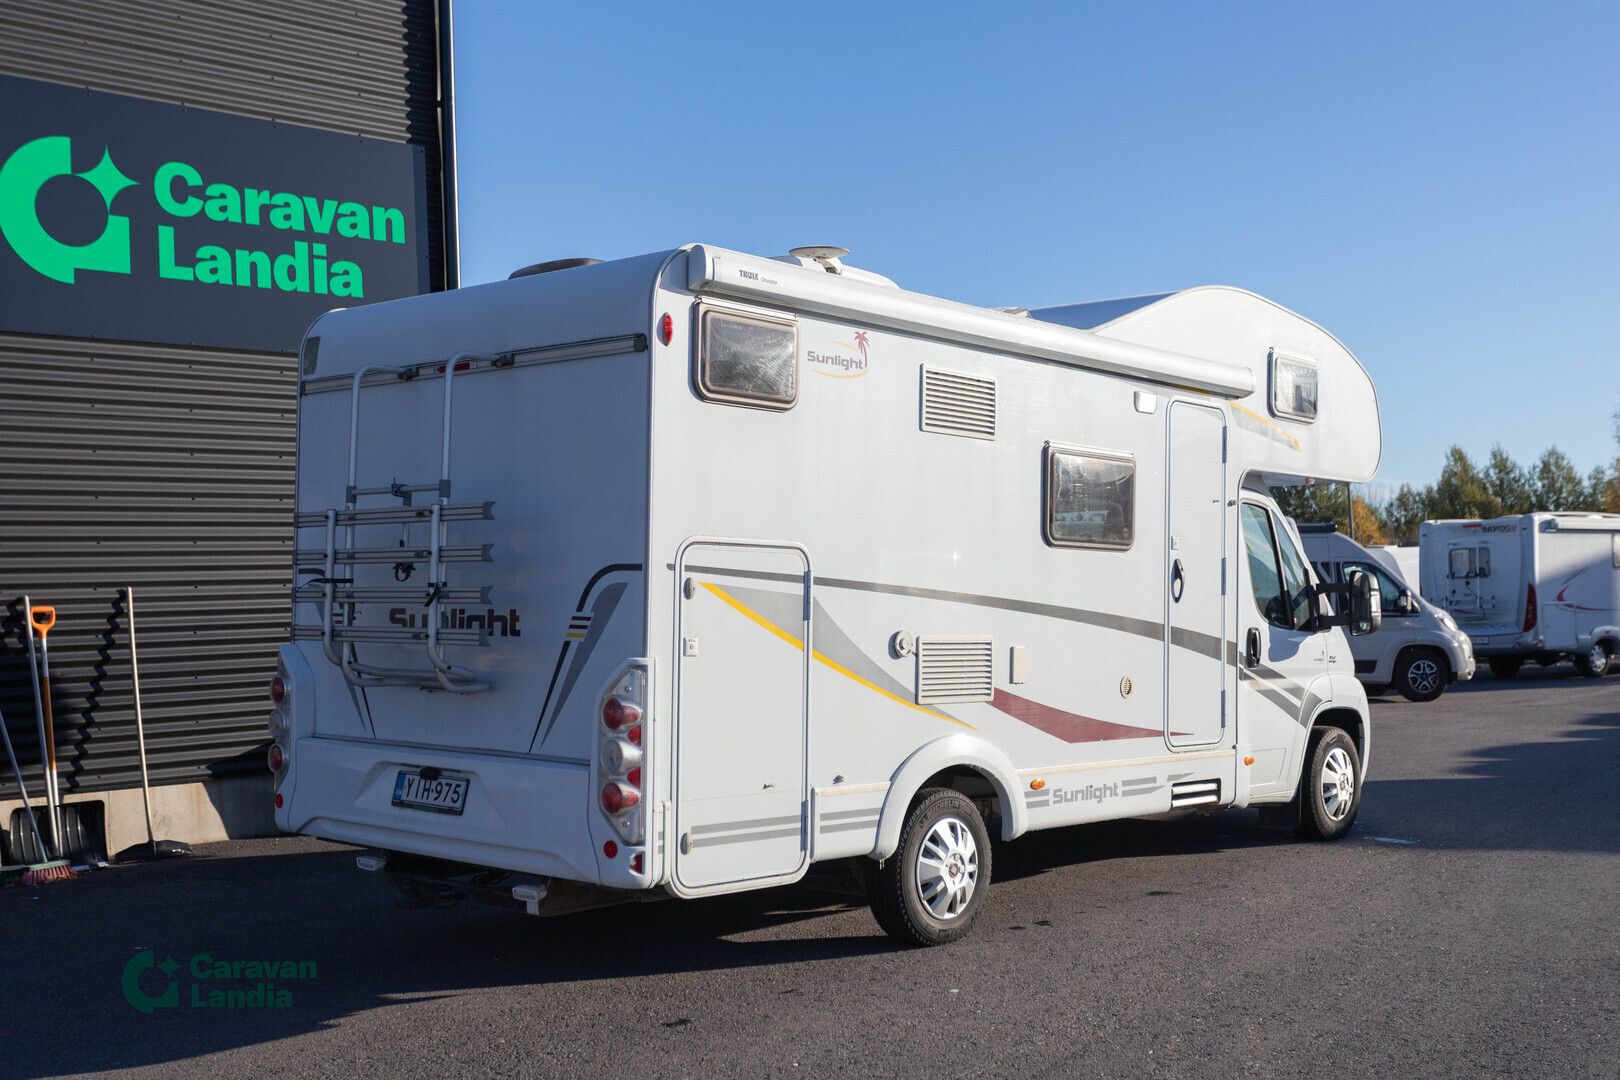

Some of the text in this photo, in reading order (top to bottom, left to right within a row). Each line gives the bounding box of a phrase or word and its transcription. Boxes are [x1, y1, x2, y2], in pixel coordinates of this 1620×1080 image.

[153, 161, 406, 245] Caravan
[157, 224, 364, 299] Landia
[807, 350, 864, 371] Sunlight
[389, 607, 522, 637] Sulight
[1052, 782, 1119, 804] Sunlight
